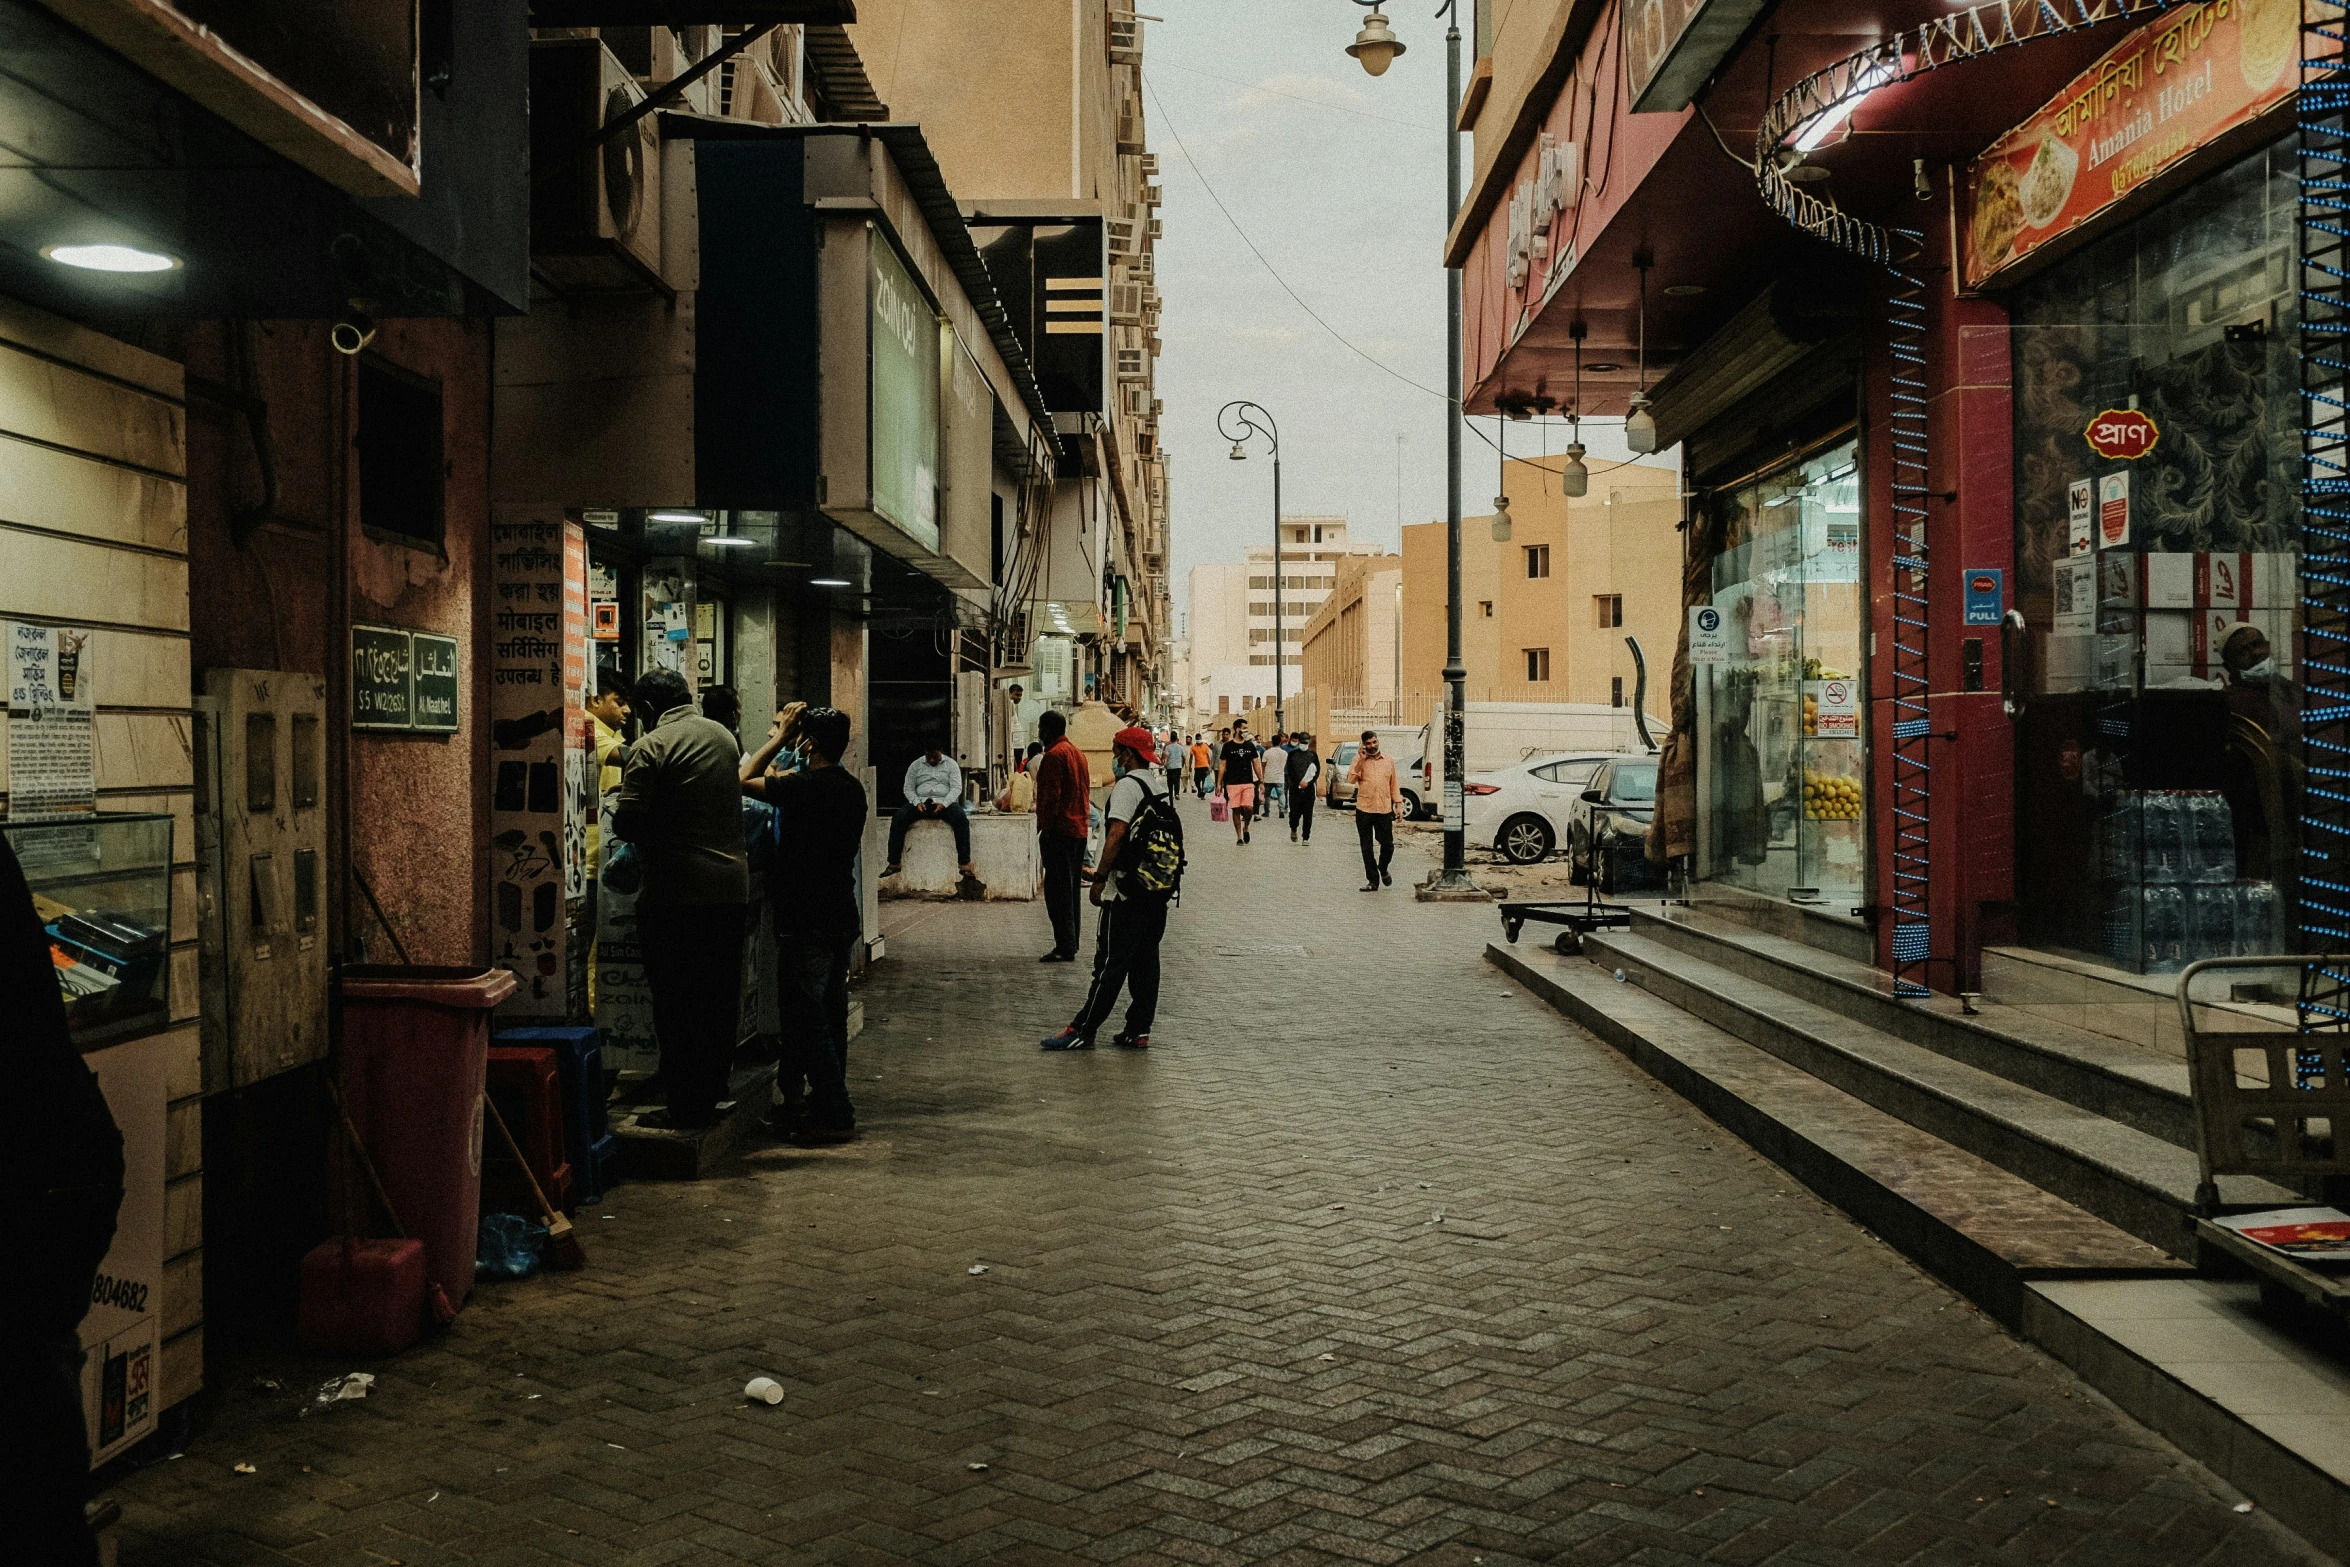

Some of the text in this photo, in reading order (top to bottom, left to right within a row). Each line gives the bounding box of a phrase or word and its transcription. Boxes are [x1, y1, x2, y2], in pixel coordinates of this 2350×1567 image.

[2087, 60, 2213, 171] Amania Hotel
[2094, 422, 2147, 446] প্রাণ
[493, 519, 560, 544] মোবাইল
[498, 583, 530, 602] করা
[536, 583, 559, 604] হয়
[497, 607, 558, 633] मोबाइल
[1969, 612, 1998, 620] PULL
[496, 637, 558, 659] सर्विसिंग
[495, 668, 542, 686] उपलब्ध
[550, 662, 561, 687] है
